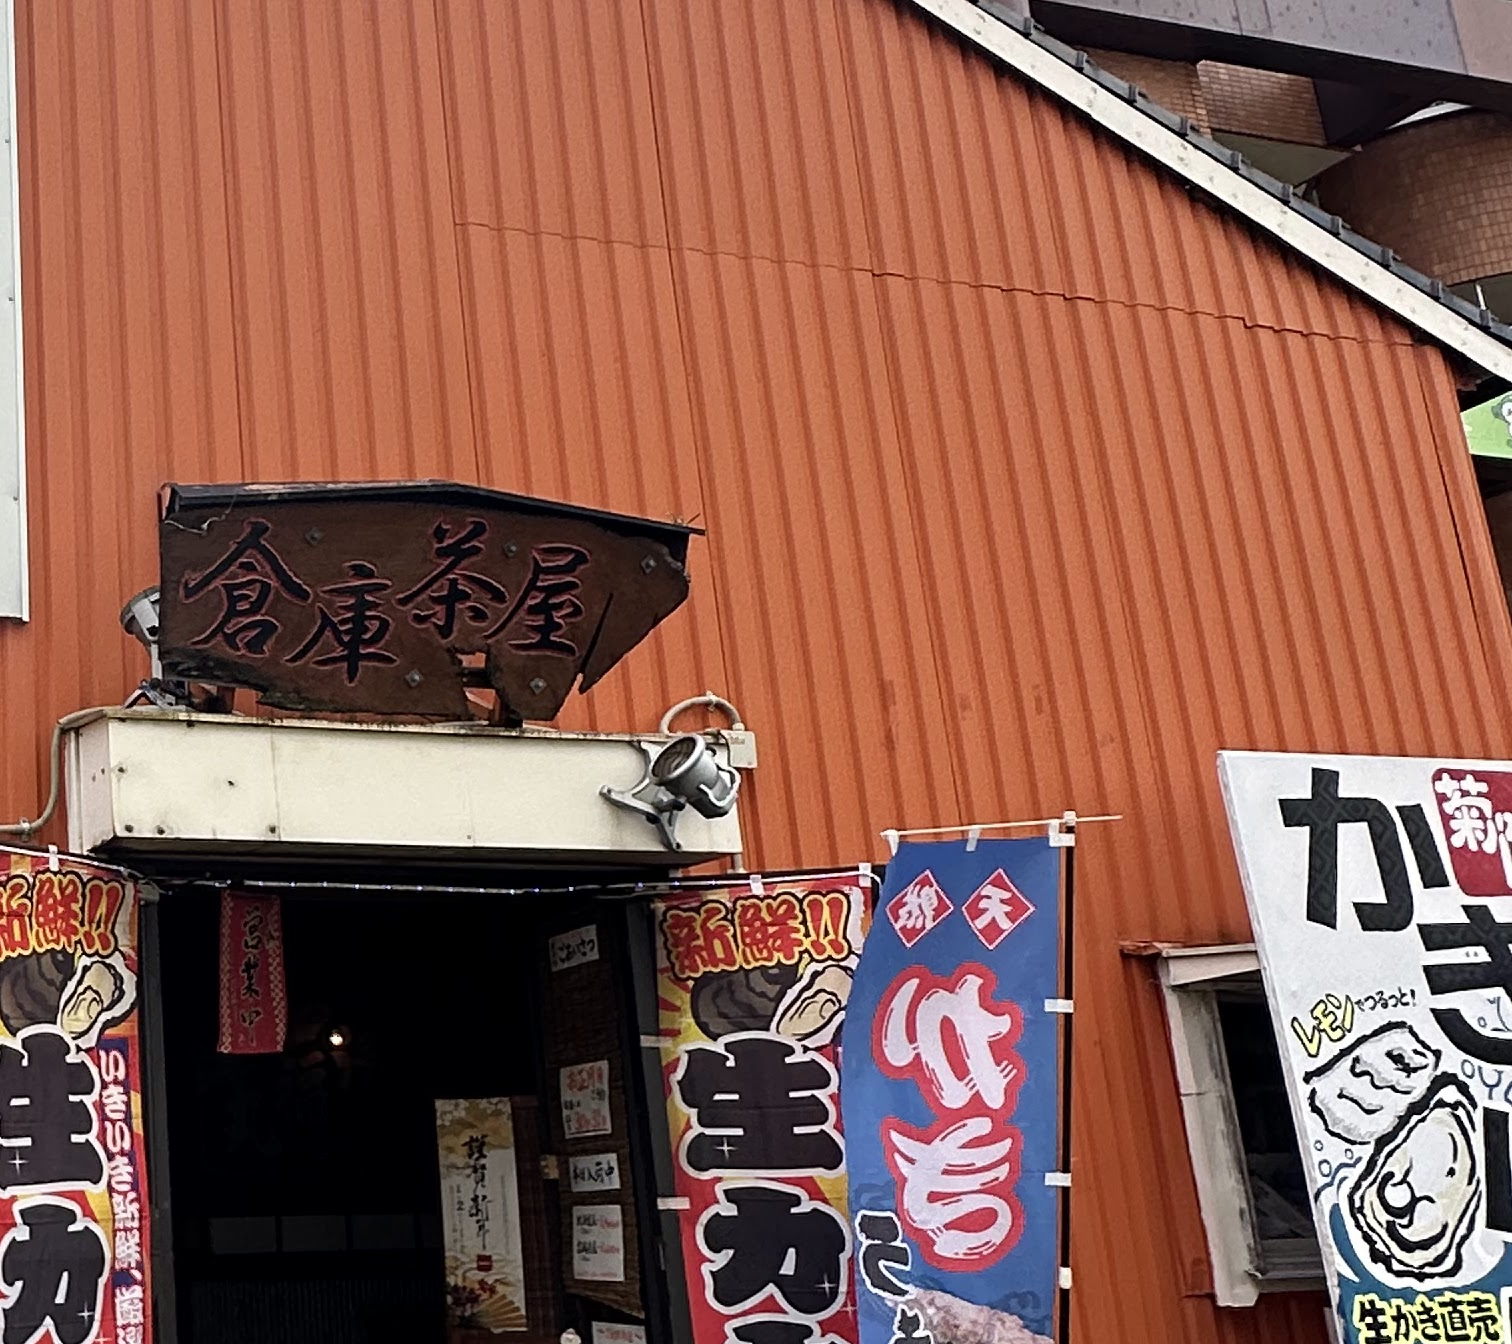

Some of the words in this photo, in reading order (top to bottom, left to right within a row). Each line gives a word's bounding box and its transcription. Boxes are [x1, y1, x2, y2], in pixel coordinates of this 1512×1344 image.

[180, 517, 592, 685] 倉庫茶屋
[662, 893, 850, 978] 新鮮!!
[1461, 1059, 1512, 1109] OY
